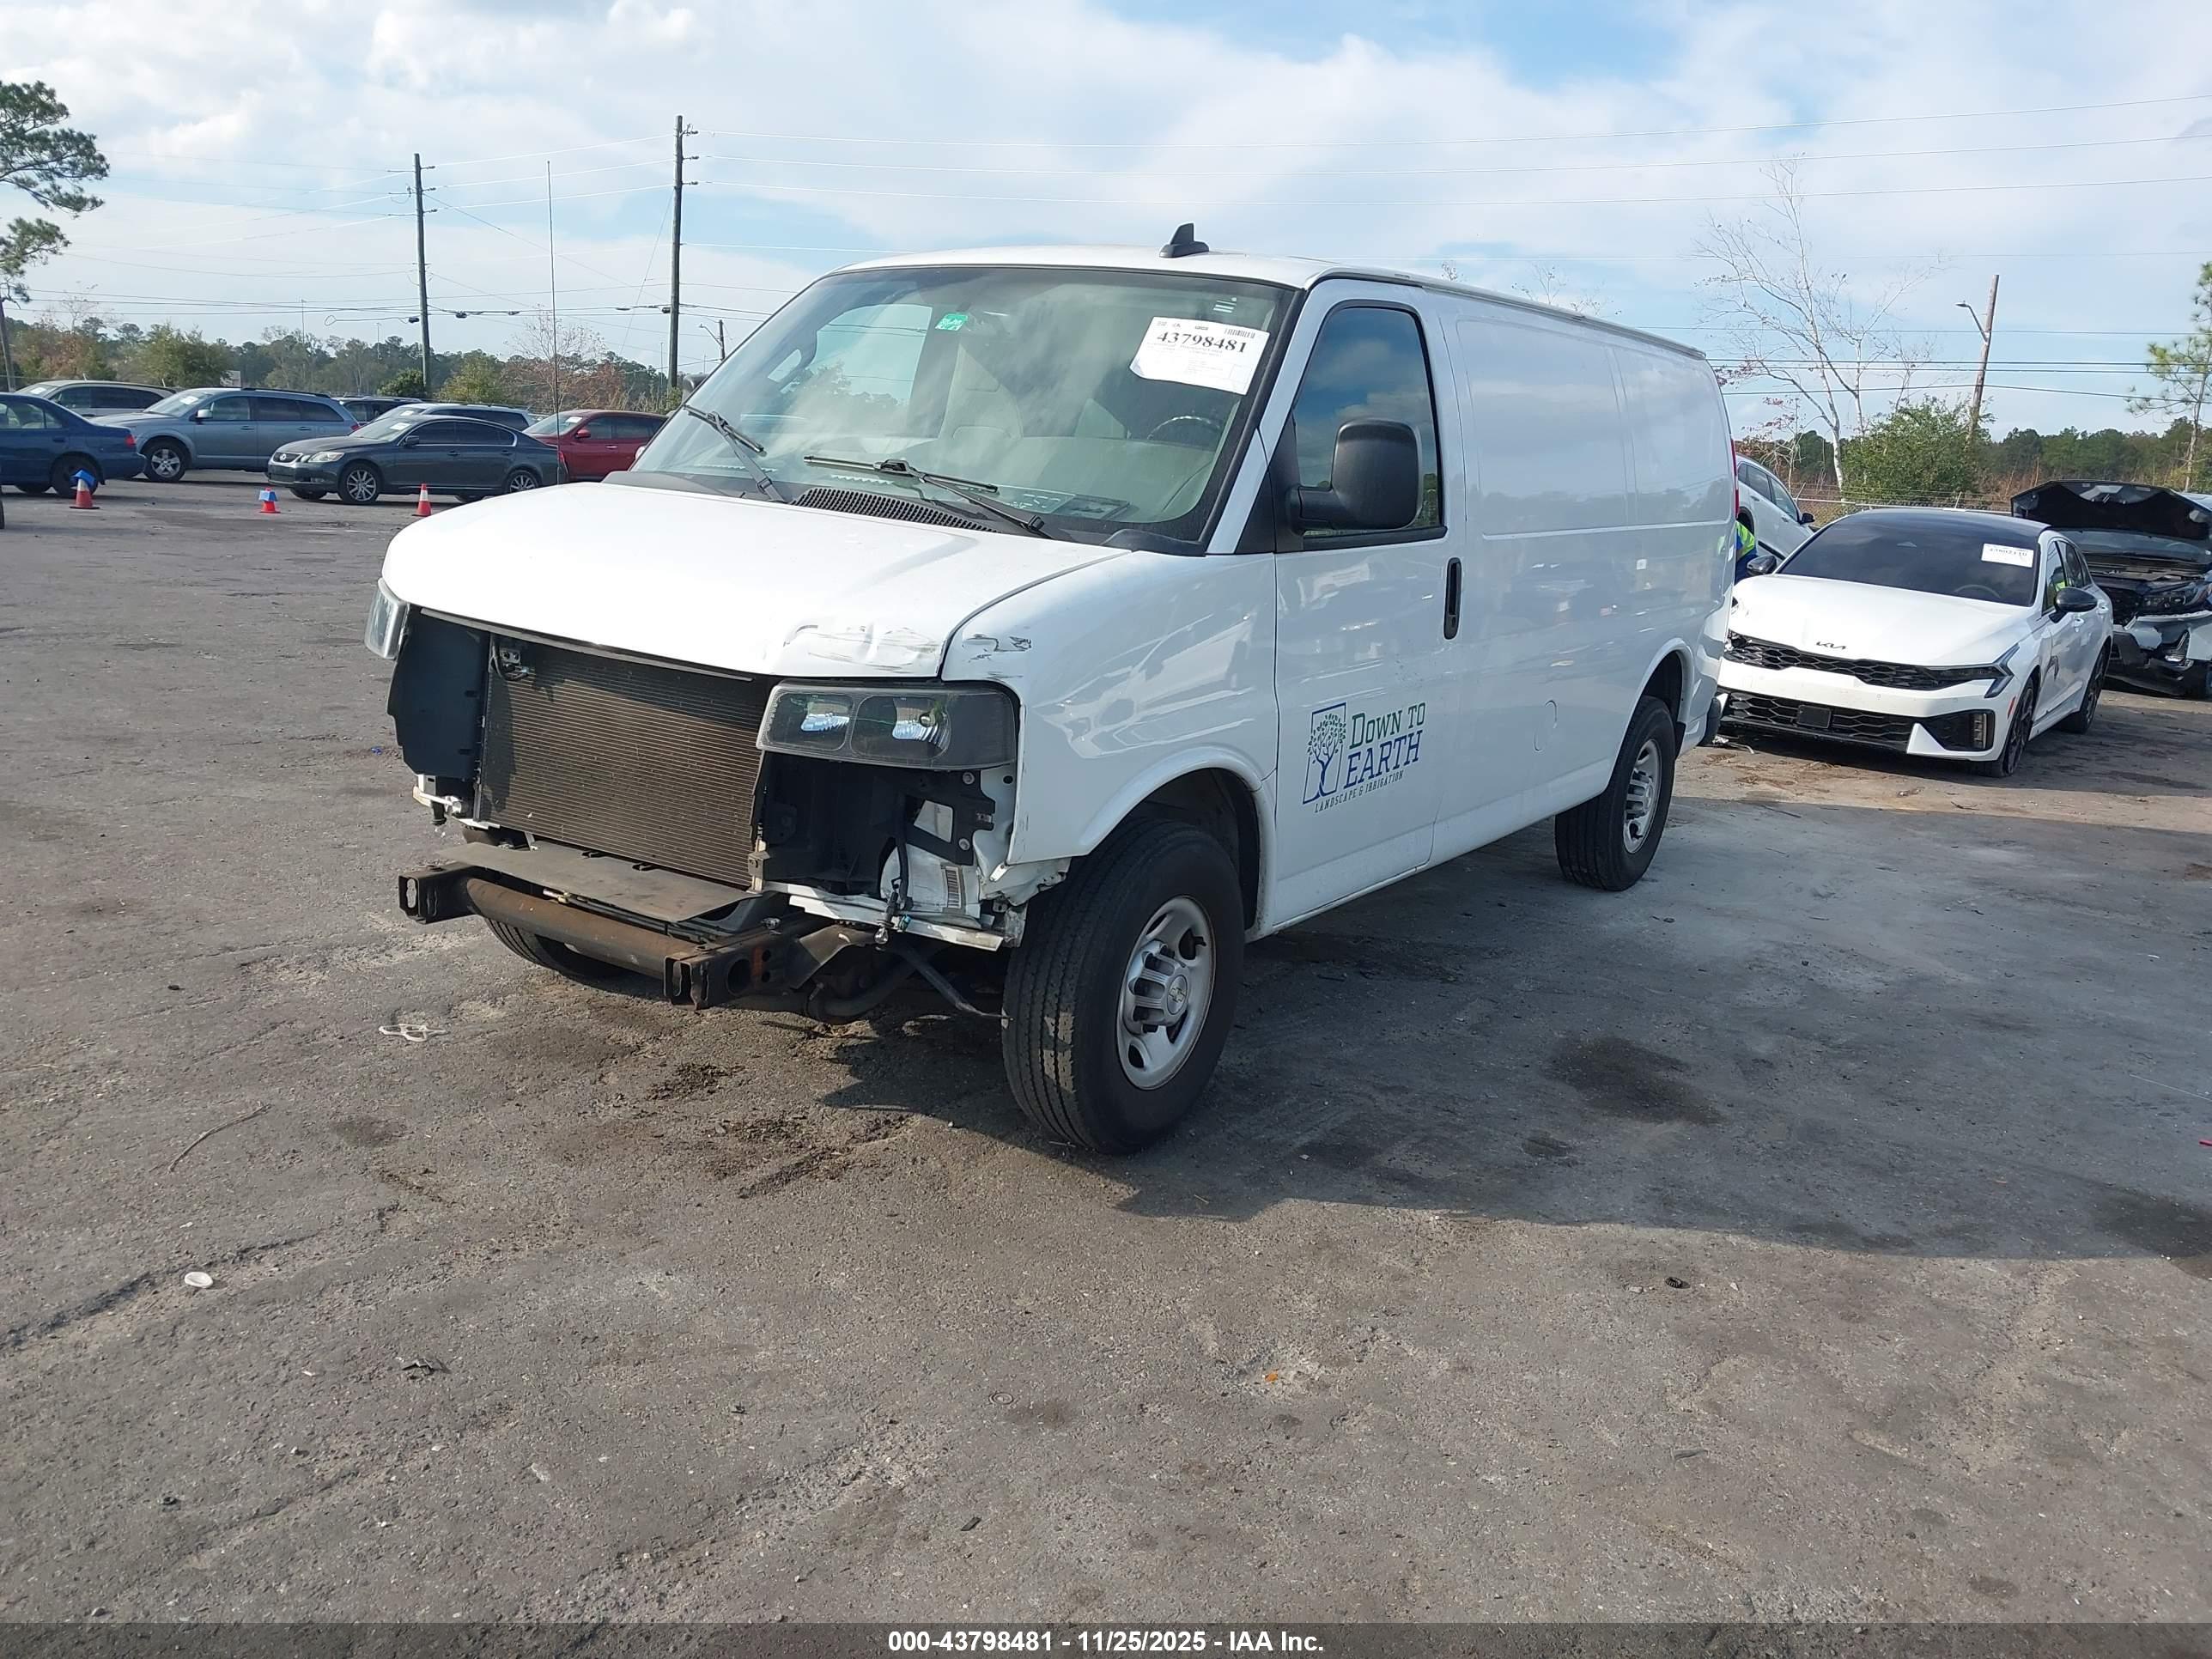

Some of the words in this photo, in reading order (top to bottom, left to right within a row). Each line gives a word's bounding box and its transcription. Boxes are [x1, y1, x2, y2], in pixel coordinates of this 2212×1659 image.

[1157, 331, 1247, 353] 43798481
[1408, 702, 1426, 729] TO
[1343, 730, 1423, 789] EARTH
[1315, 787, 1358, 813] LANDSCAPE
[1365, 769, 1404, 793] IRRIGATION
